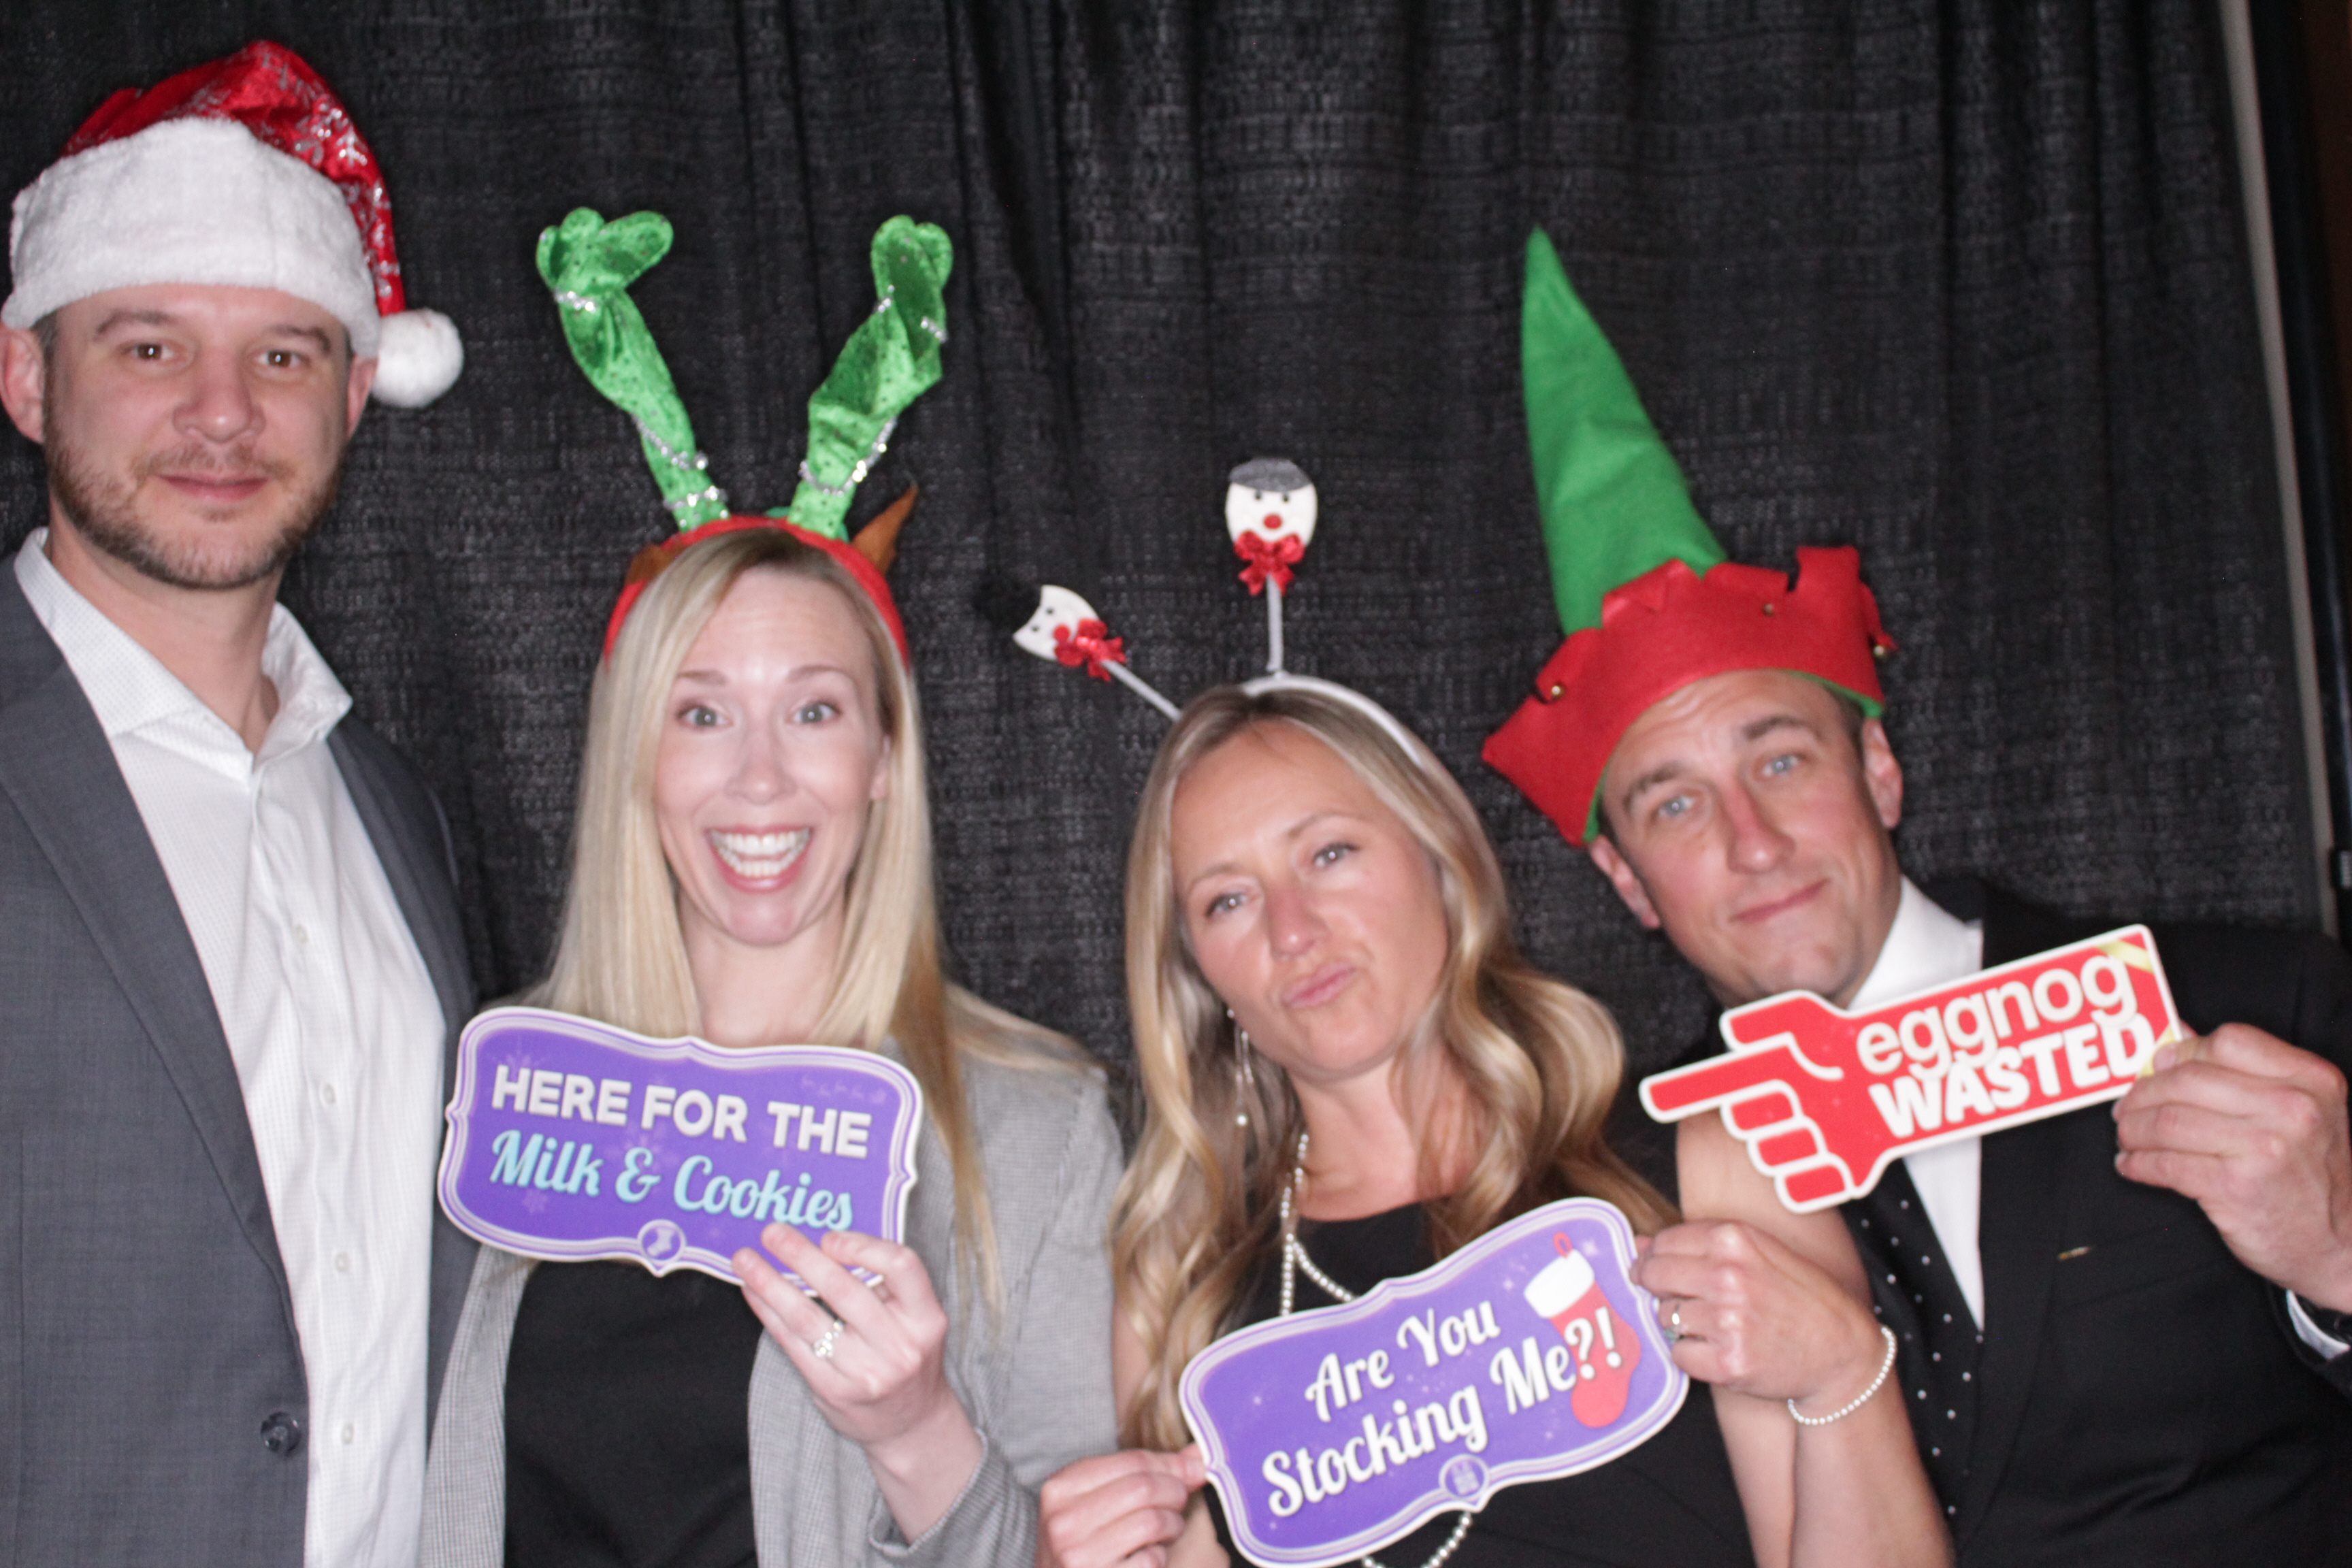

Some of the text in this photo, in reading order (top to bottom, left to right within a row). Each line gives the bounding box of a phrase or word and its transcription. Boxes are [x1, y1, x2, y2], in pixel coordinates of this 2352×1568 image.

[1857, 956, 2138, 1081] eggnog
[1868, 1013, 2154, 1138] WASTED
[491, 1065, 872, 1158] HERE FOR THE
[489, 1130, 853, 1231] Milk & Cookies
[1262, 1307, 1622, 1517] Stocking Me?!
[1305, 1301, 1501, 1422] Are You
